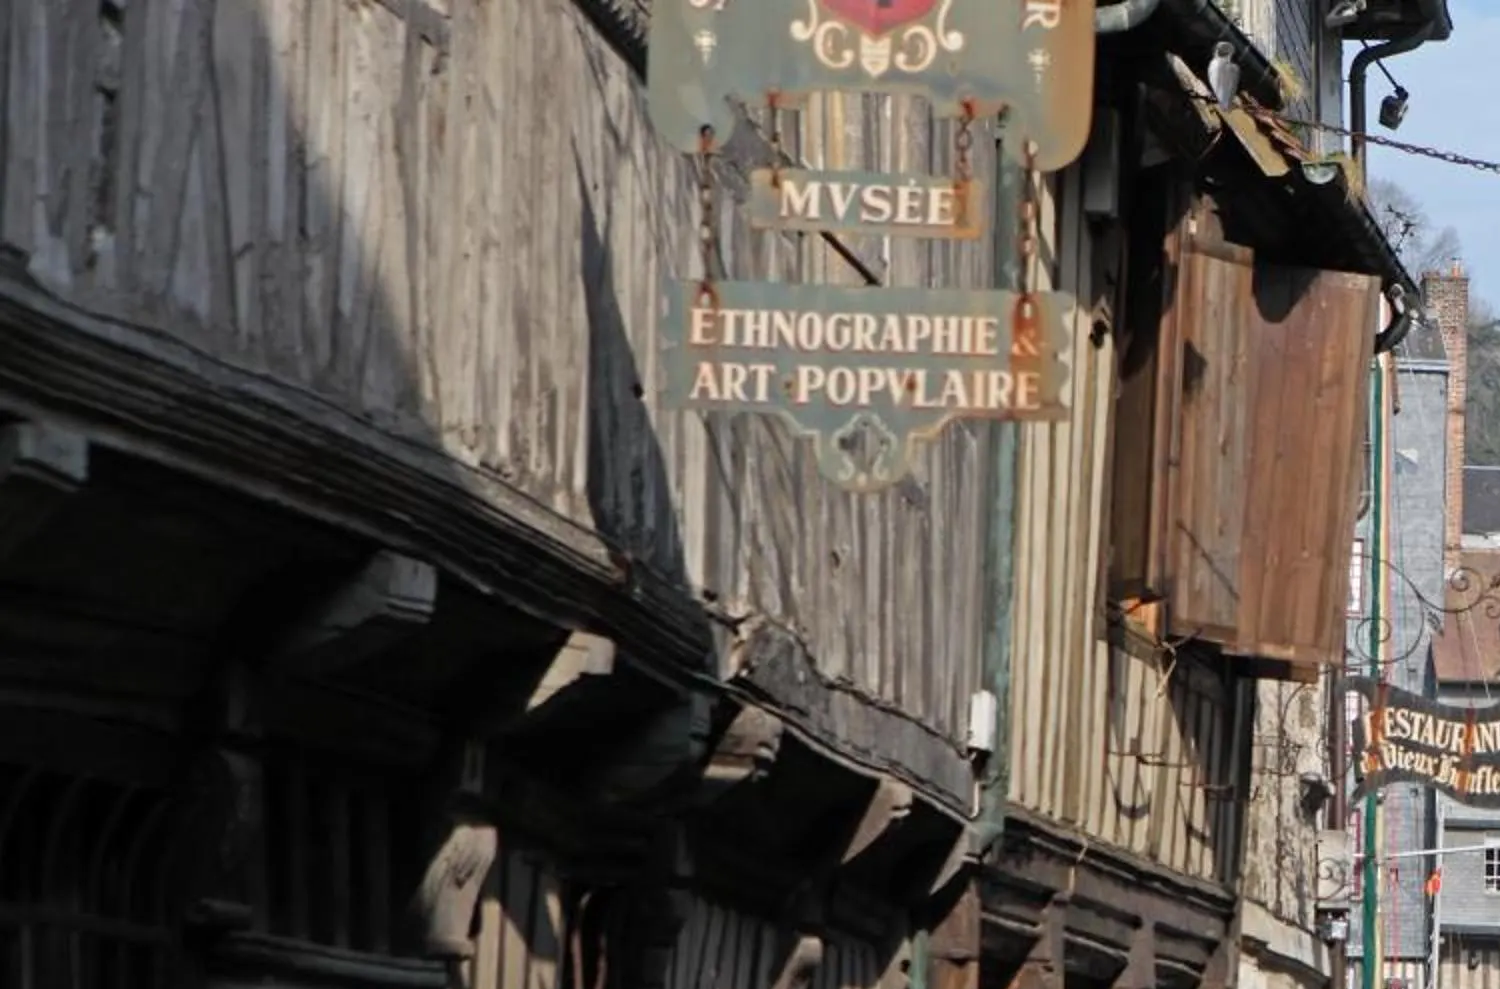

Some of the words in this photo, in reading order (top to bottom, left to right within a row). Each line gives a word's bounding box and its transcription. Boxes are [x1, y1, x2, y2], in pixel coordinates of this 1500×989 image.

[689, 308, 999, 356] ETHNOGRAPHIE
[1011, 330, 1042, 356] &
[689, 362, 776, 402] ART
[795, 365, 1041, 410] POPVLAIRE
